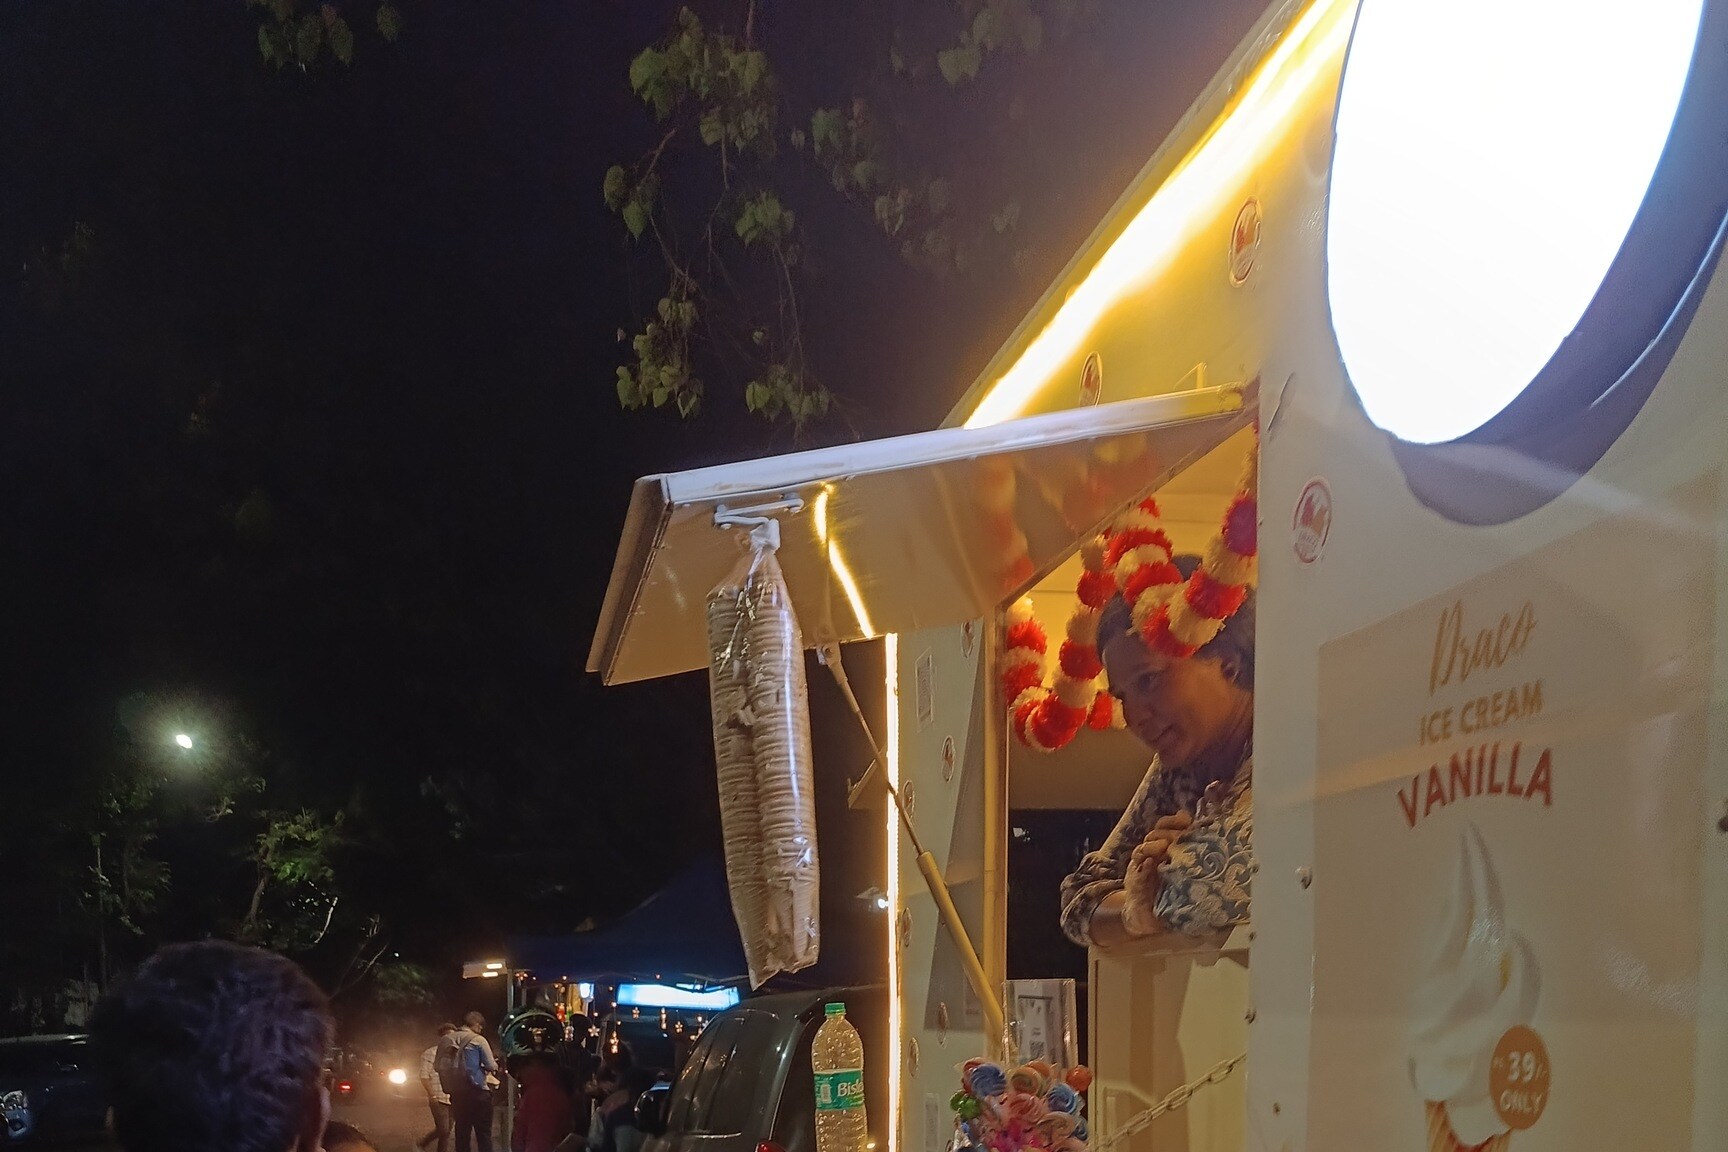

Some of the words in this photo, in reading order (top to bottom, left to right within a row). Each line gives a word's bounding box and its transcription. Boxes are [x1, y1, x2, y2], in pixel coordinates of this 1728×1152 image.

[1428, 598, 1539, 696] Draco
[1419, 711, 1454, 747] ICE
[1458, 679, 1545, 737] CREAM
[1397, 740, 1554, 830] VANILLA
[1499, 1088, 1542, 1113] ONLY
